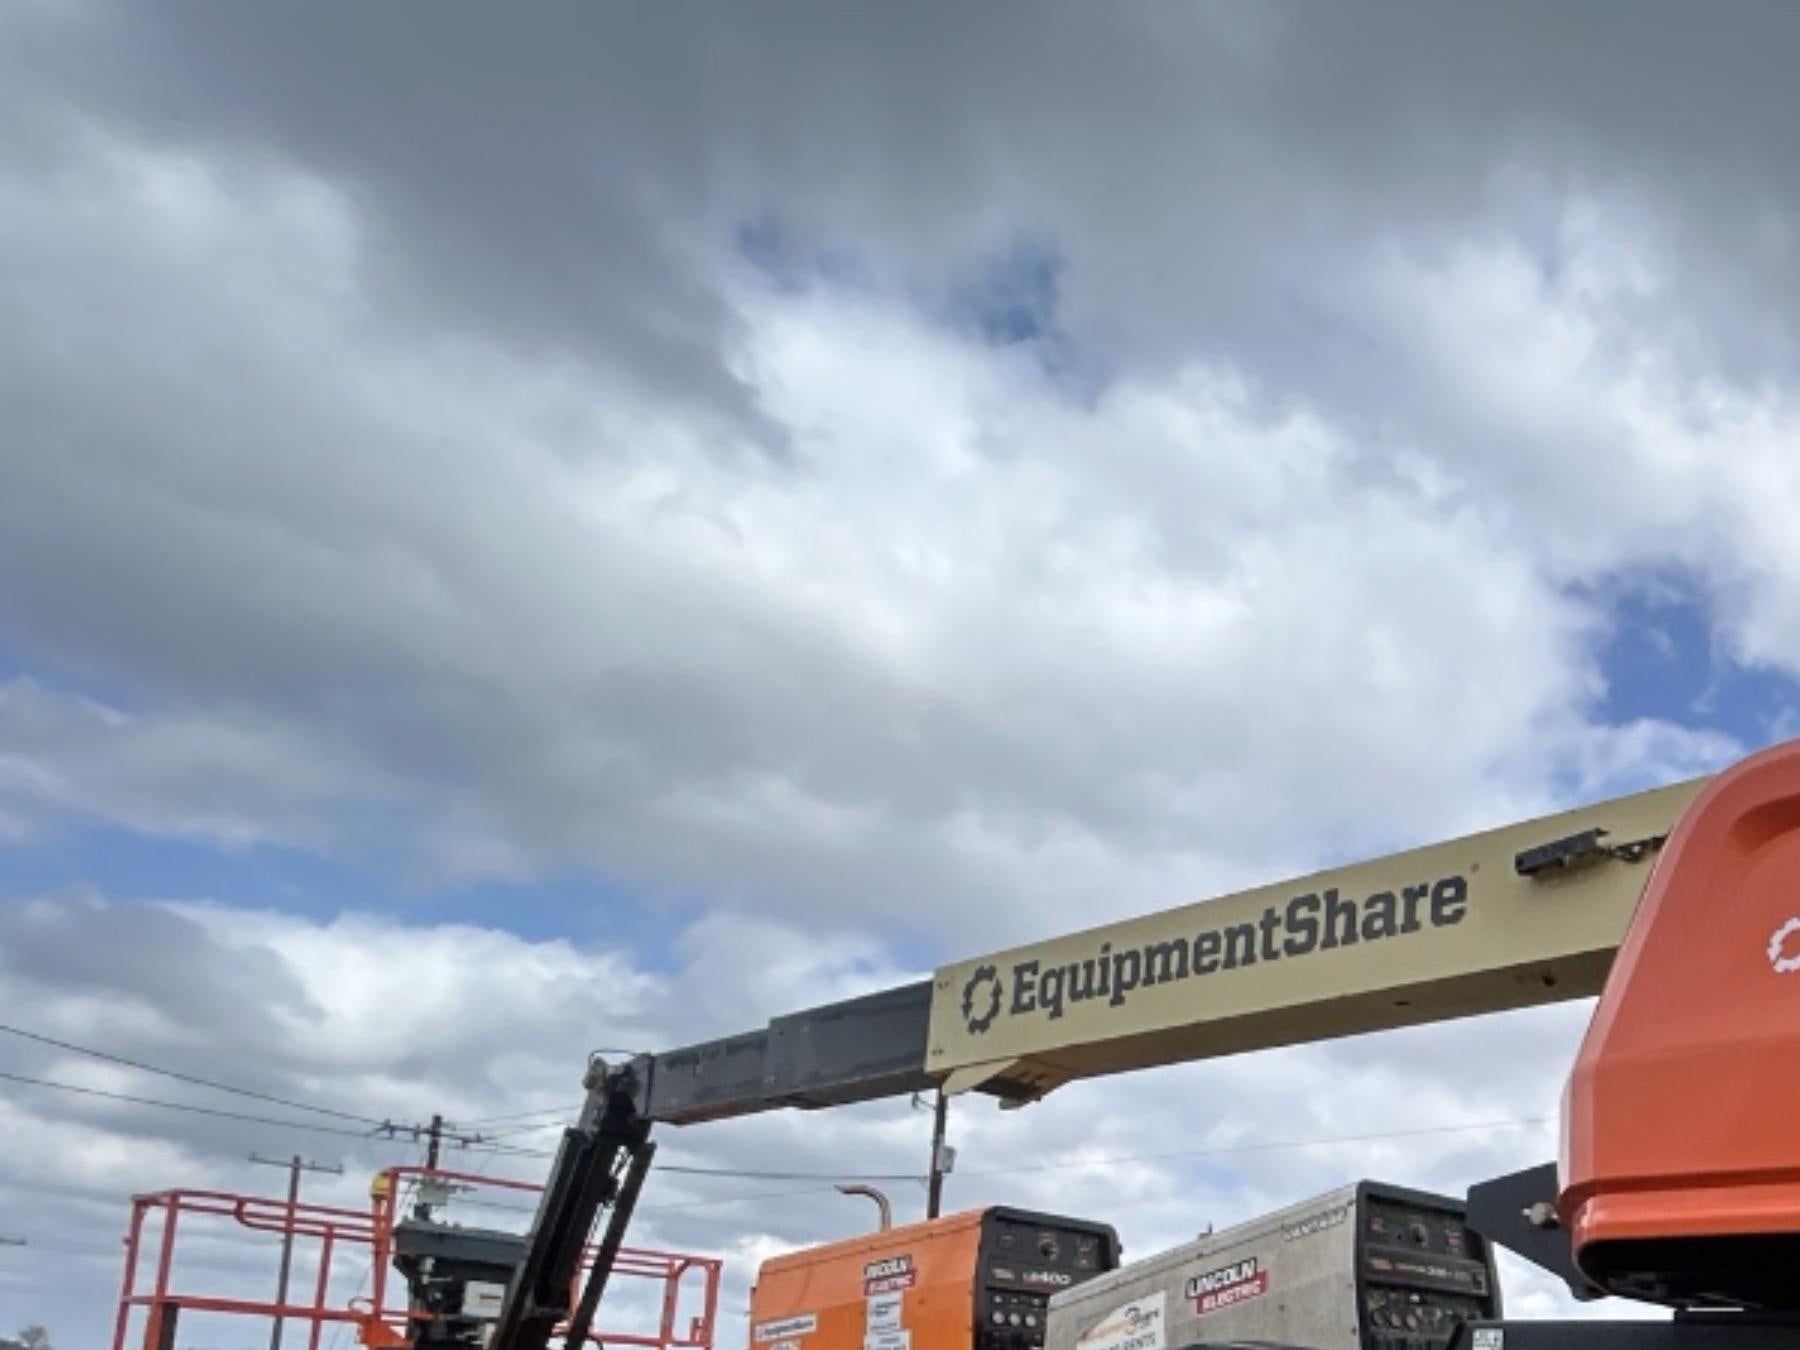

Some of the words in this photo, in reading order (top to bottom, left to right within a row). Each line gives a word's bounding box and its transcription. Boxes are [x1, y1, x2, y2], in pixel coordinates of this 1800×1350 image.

[1009, 874, 1469, 1019] EquipmentShare
[1187, 1257, 1257, 1298] LINCOLN
[1201, 1279, 1263, 1312] ELECTRIC
